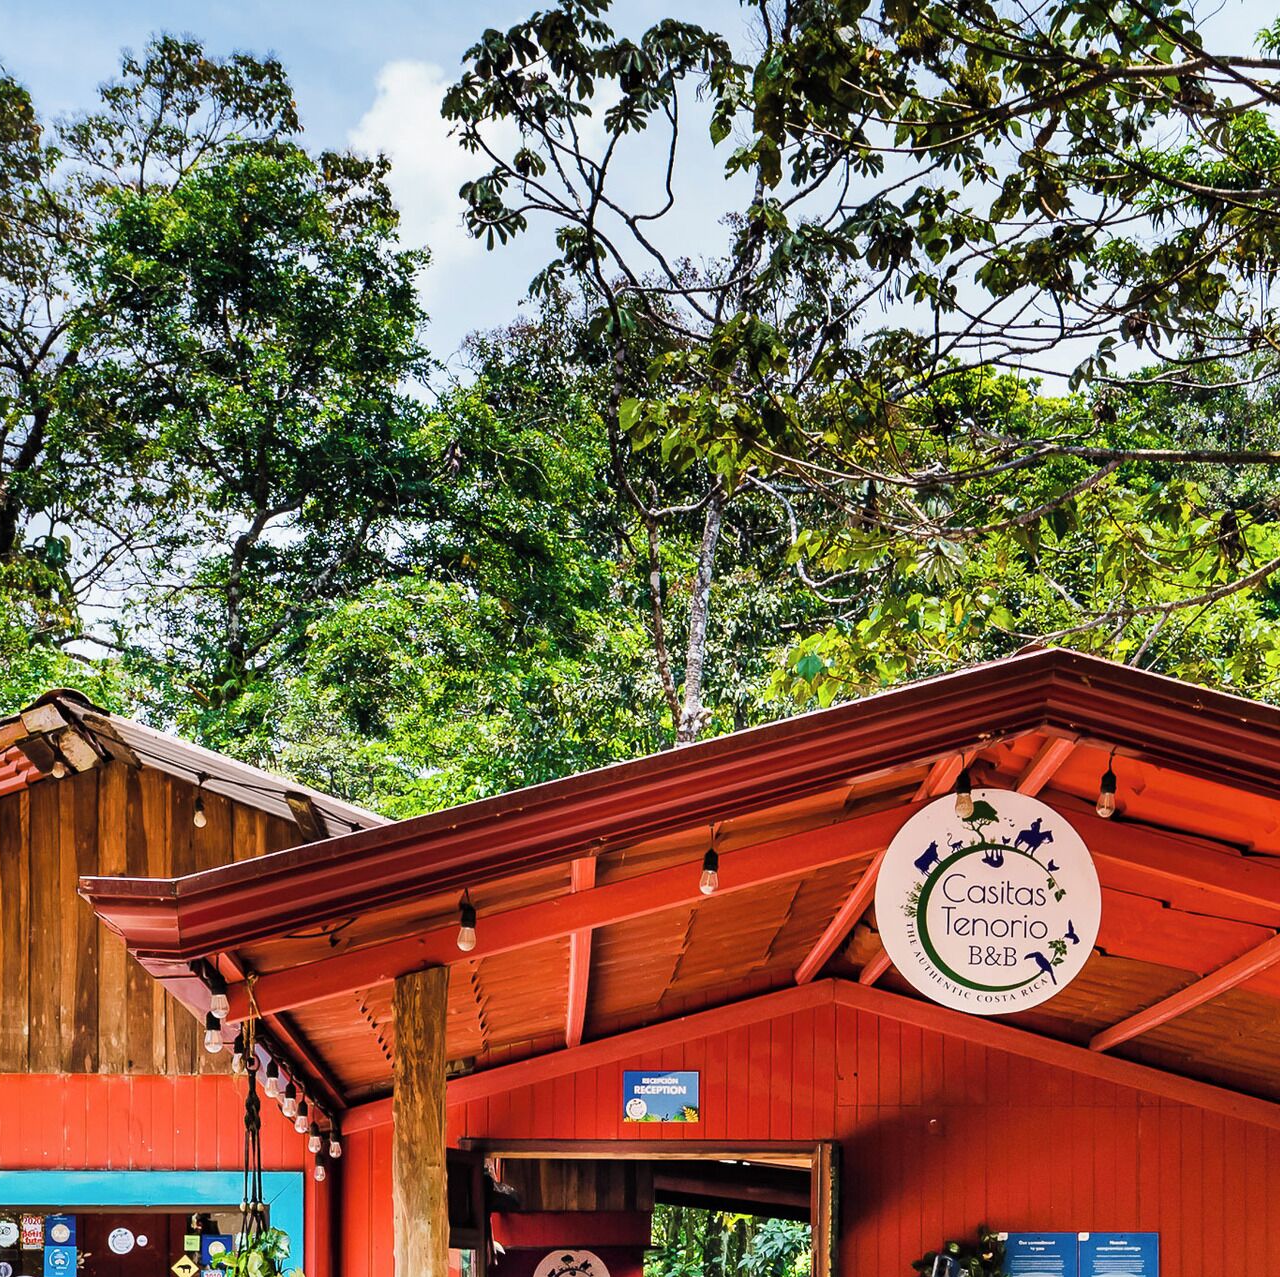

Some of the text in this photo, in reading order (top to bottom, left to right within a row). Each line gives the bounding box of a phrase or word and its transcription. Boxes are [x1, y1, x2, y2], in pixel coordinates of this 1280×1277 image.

[942, 873, 1046, 906] Casitas
[941, 906, 1048, 939] Tenorio
[906, 922, 1049, 1003] THE AUTHENTIC COSTA RICA
[968, 945, 1018, 967] B&B
[633, 1085, 687, 1095] RECEPTION
